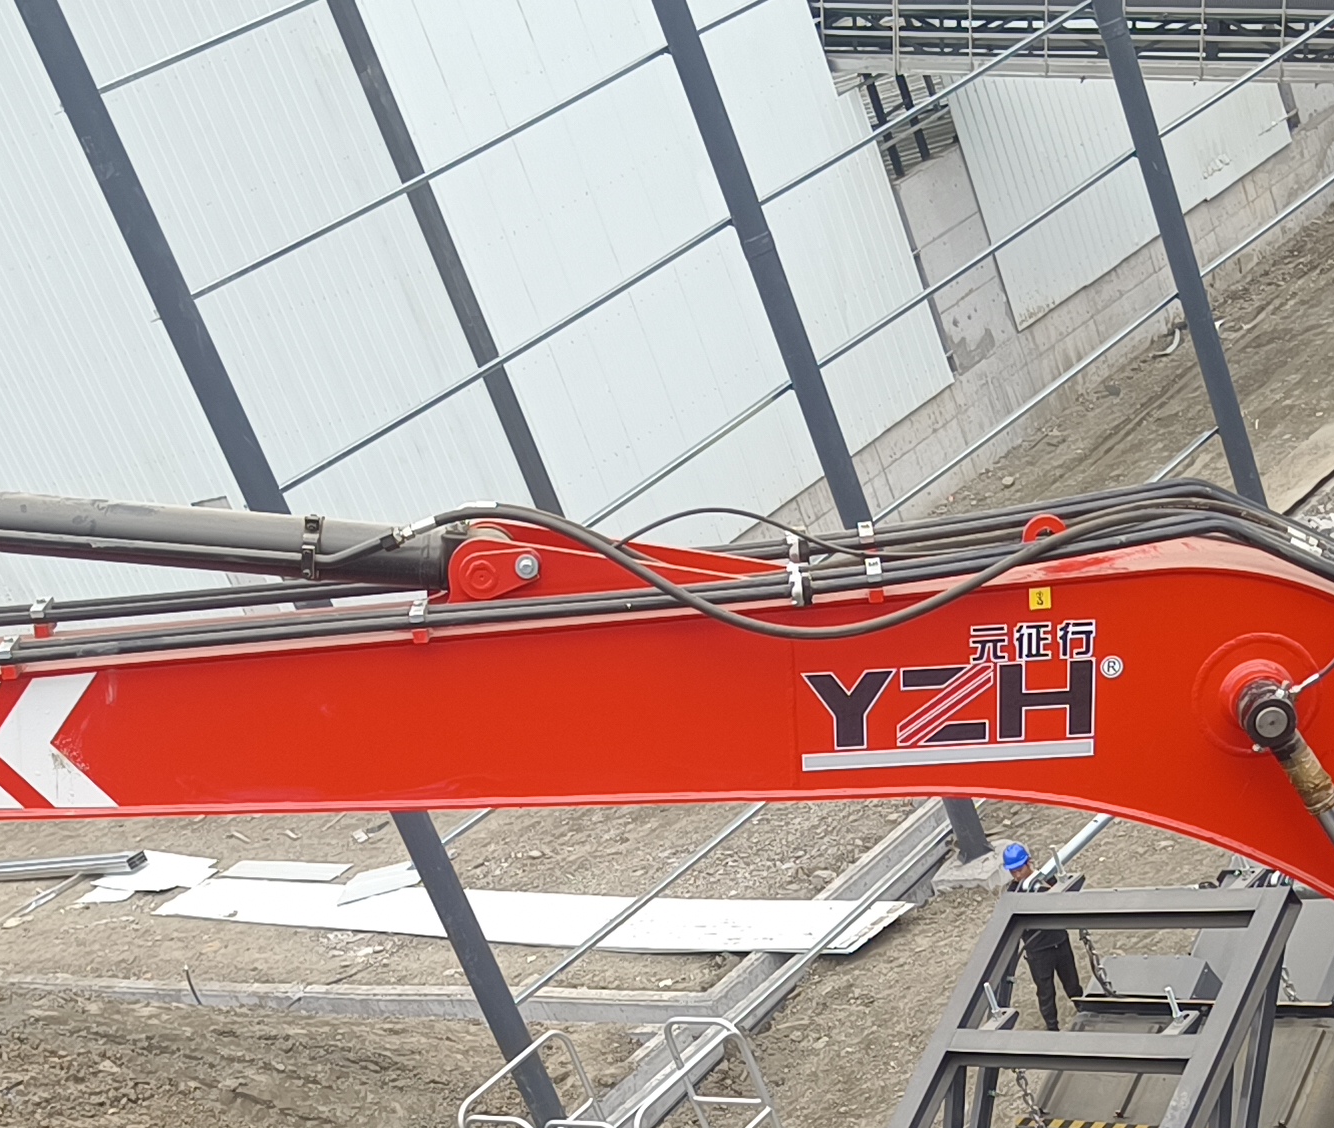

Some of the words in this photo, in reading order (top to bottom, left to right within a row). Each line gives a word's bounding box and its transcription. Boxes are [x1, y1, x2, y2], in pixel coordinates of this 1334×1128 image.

[969, 618, 1096, 665] 元征行
[801, 657, 1096, 751] YZH
